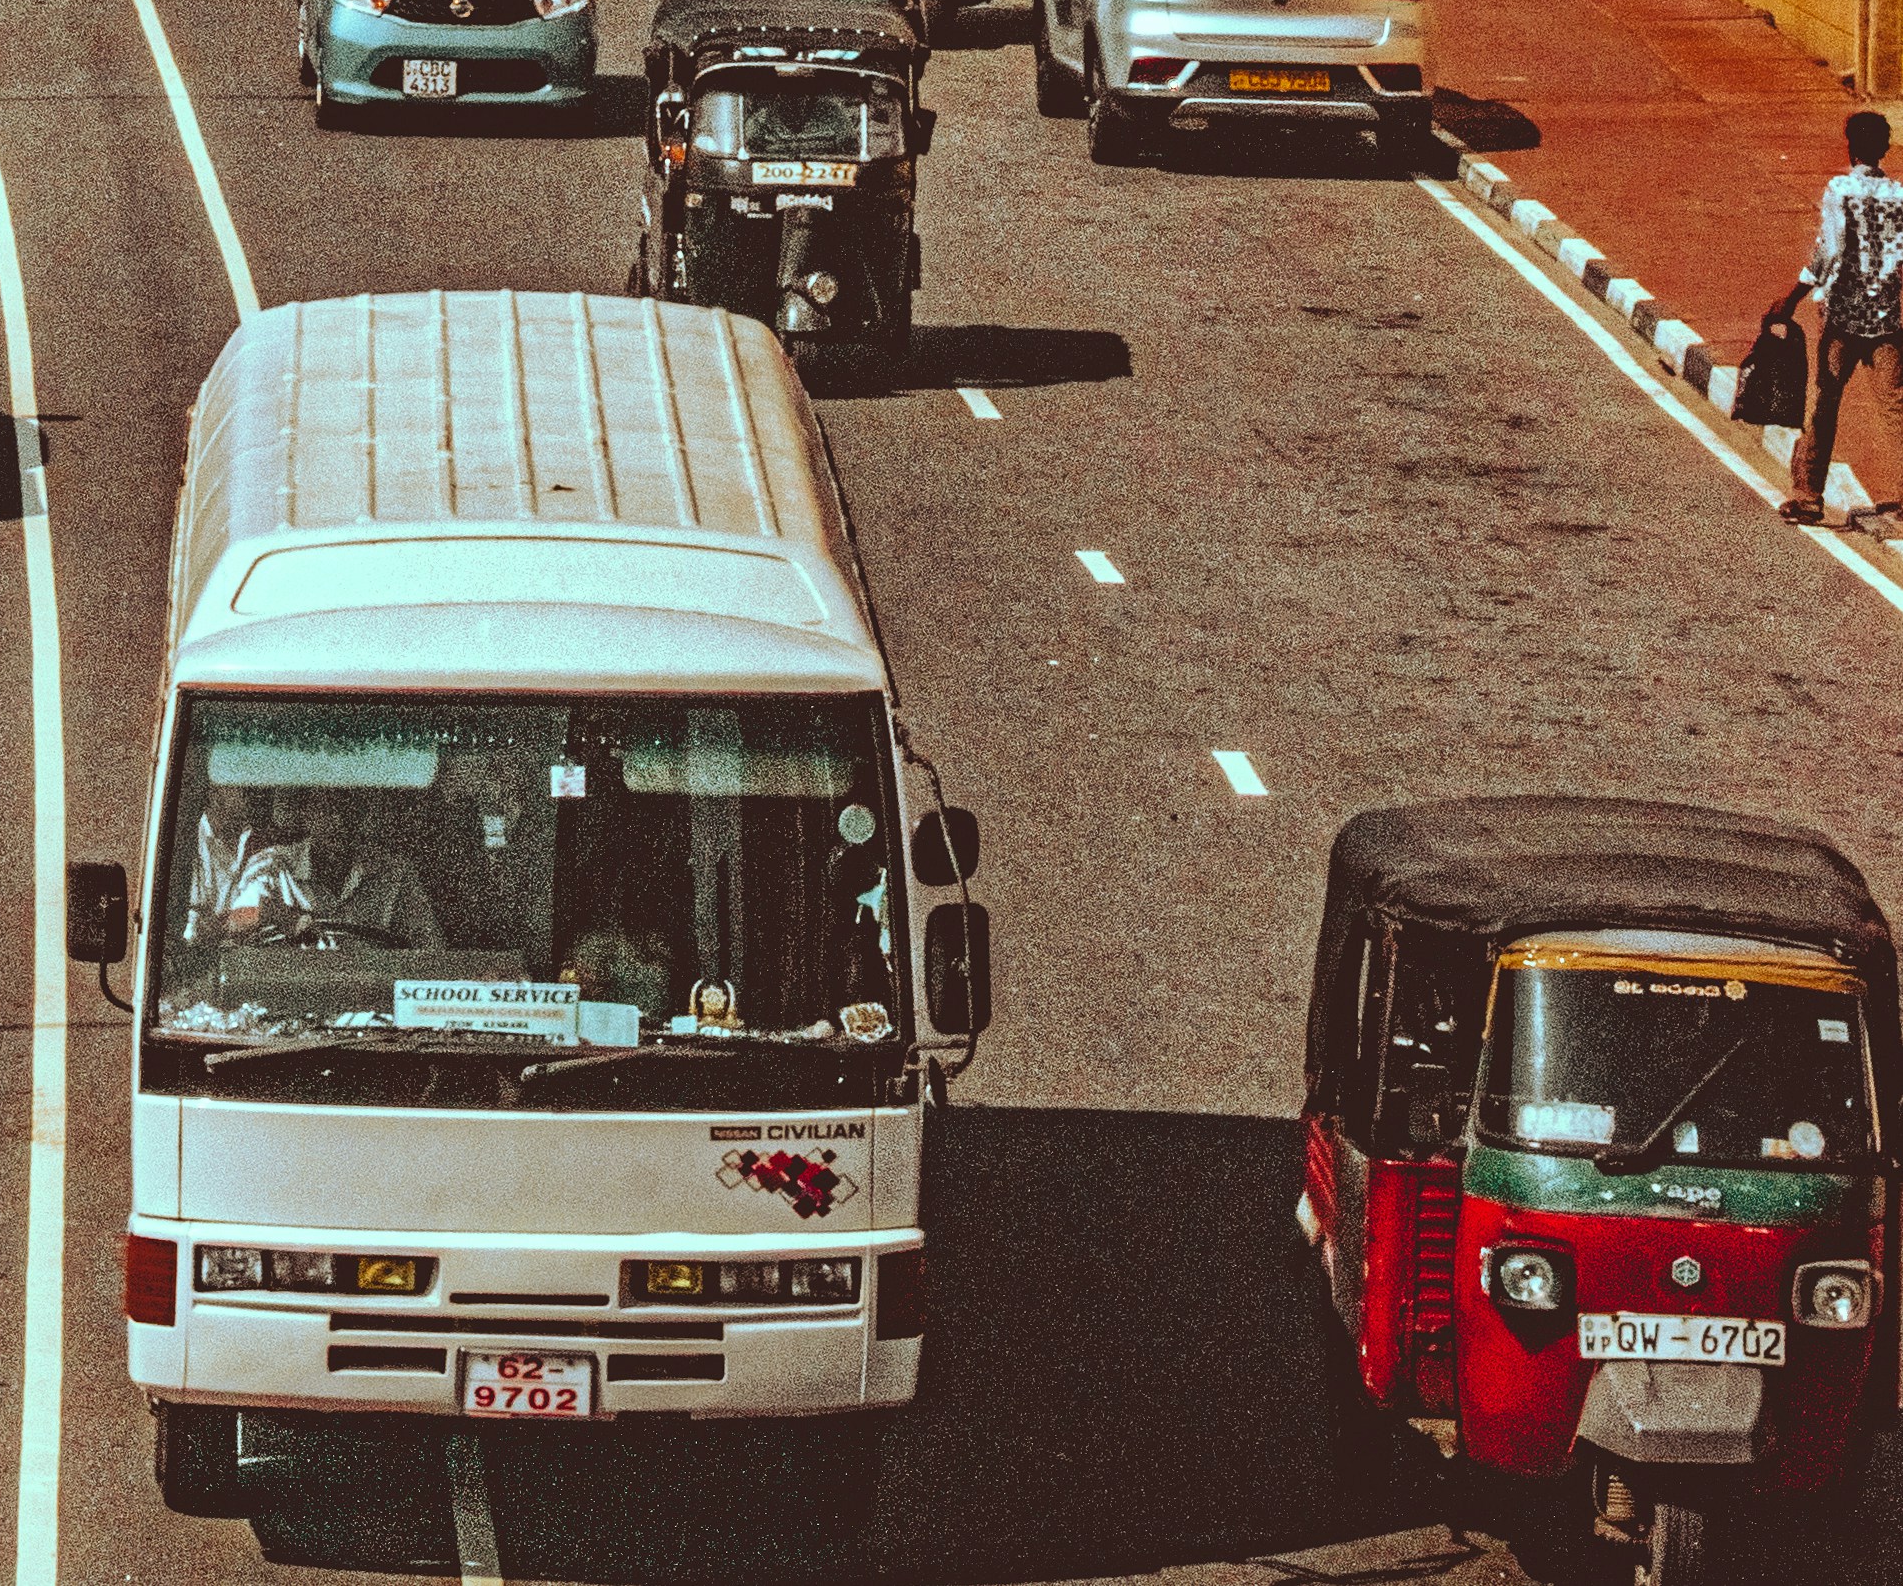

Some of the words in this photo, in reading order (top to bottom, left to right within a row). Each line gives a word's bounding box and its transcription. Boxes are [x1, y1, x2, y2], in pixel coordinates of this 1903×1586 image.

[397, 985, 482, 1002] SCHOOL
[488, 988, 578, 1004] SERVICE
[767, 1123, 866, 1141] CIVILIAN
[1666, 1184, 1723, 1203] ape
[473, 1385, 578, 1411] 9702
